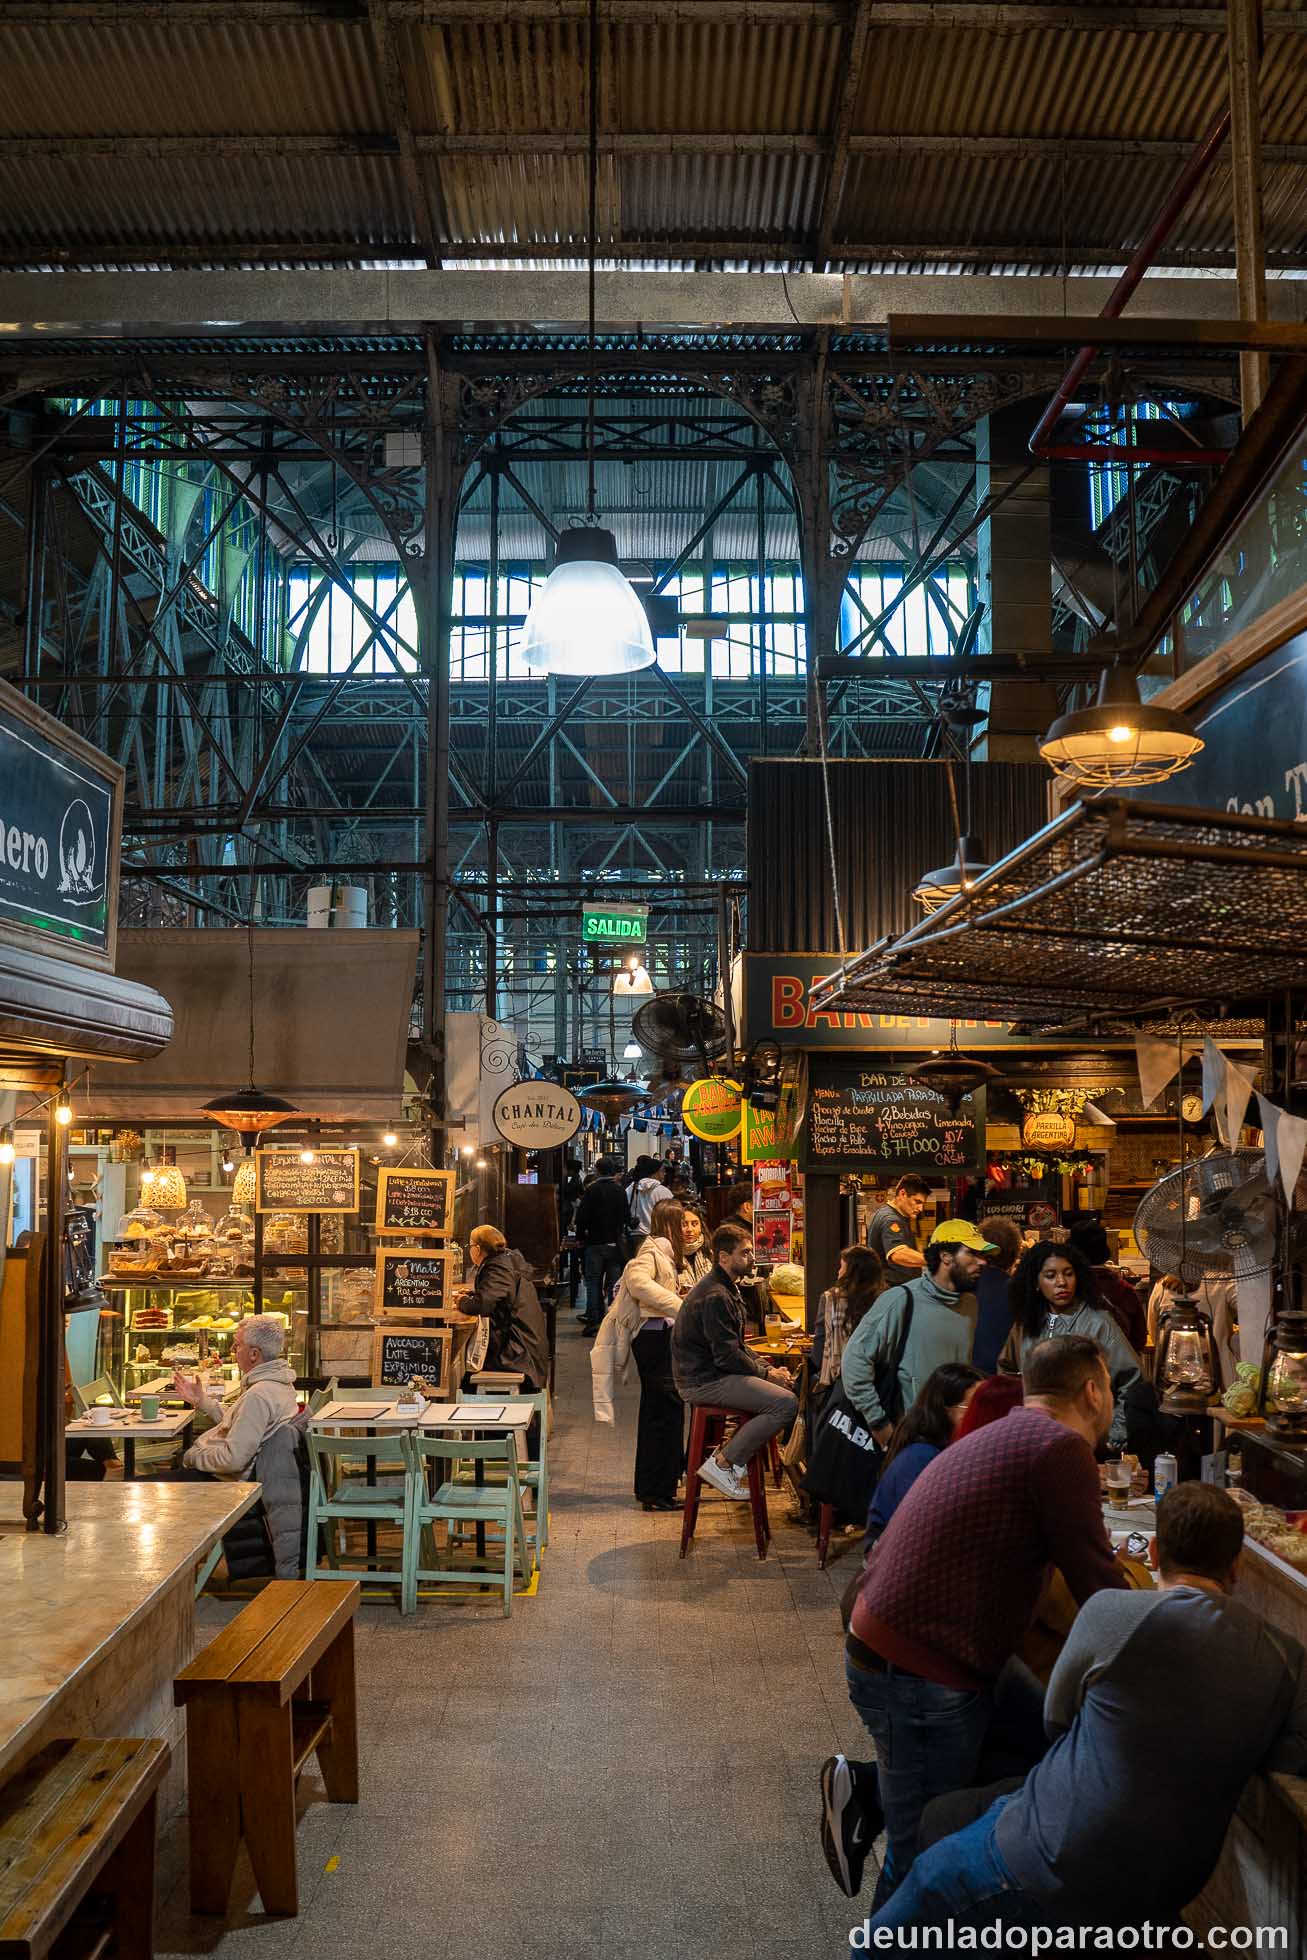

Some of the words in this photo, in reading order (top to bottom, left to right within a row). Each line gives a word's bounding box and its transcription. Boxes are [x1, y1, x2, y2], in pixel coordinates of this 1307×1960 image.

[587, 918, 642, 937] SALIDA
[860, 1073, 887, 1087] BAR
[698, 1083, 727, 1101] BAR
[501, 1104, 575, 1122] CHANTAL
[891, 1105, 932, 1120] Bebidas
[1036, 1122, 1067, 1130] PARRILLA
[1031, 1131, 1068, 1139] ARGENTINA
[935, 1152, 966, 1166] CASH
[409, 1261, 440, 1274] Mate
[385, 1337, 425, 1349] AVOCADO
[385, 1349, 411, 1360] LATTE
[384, 1361, 436, 1373] EXPRIMIDO
